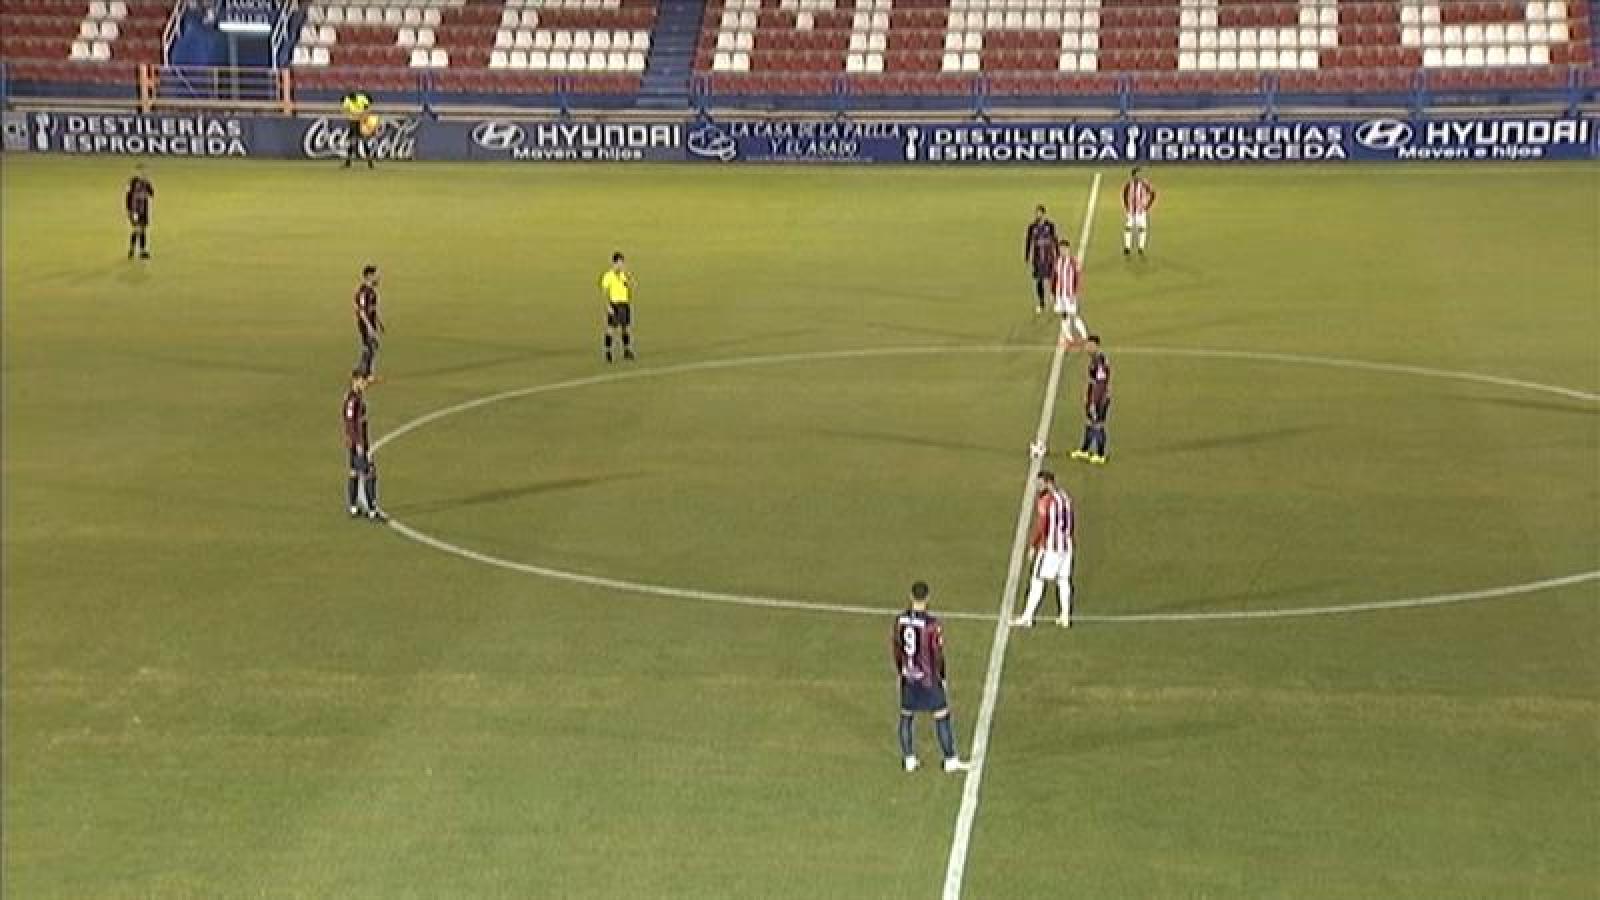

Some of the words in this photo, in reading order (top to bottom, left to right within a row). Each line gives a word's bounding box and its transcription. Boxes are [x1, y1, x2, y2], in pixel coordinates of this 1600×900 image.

[68, 114, 241, 135] DESTILERÍAS
[935, 124, 1114, 144] DESTILERÍAS
[1157, 124, 1342, 144] DESTILERÍAS
[1427, 120, 1588, 144] HYUNDAI
[63, 134, 248, 156] ESPRONCEDA
[537, 124, 680, 148] HYUNDAI
[597, 147, 642, 161] hijos
[929, 144, 1119, 161] ESPRONCEDA
[1149, 144, 1346, 161] ESPRONCEDA
[1491, 146, 1543, 160] hijos
[903, 626, 917, 656] 9
